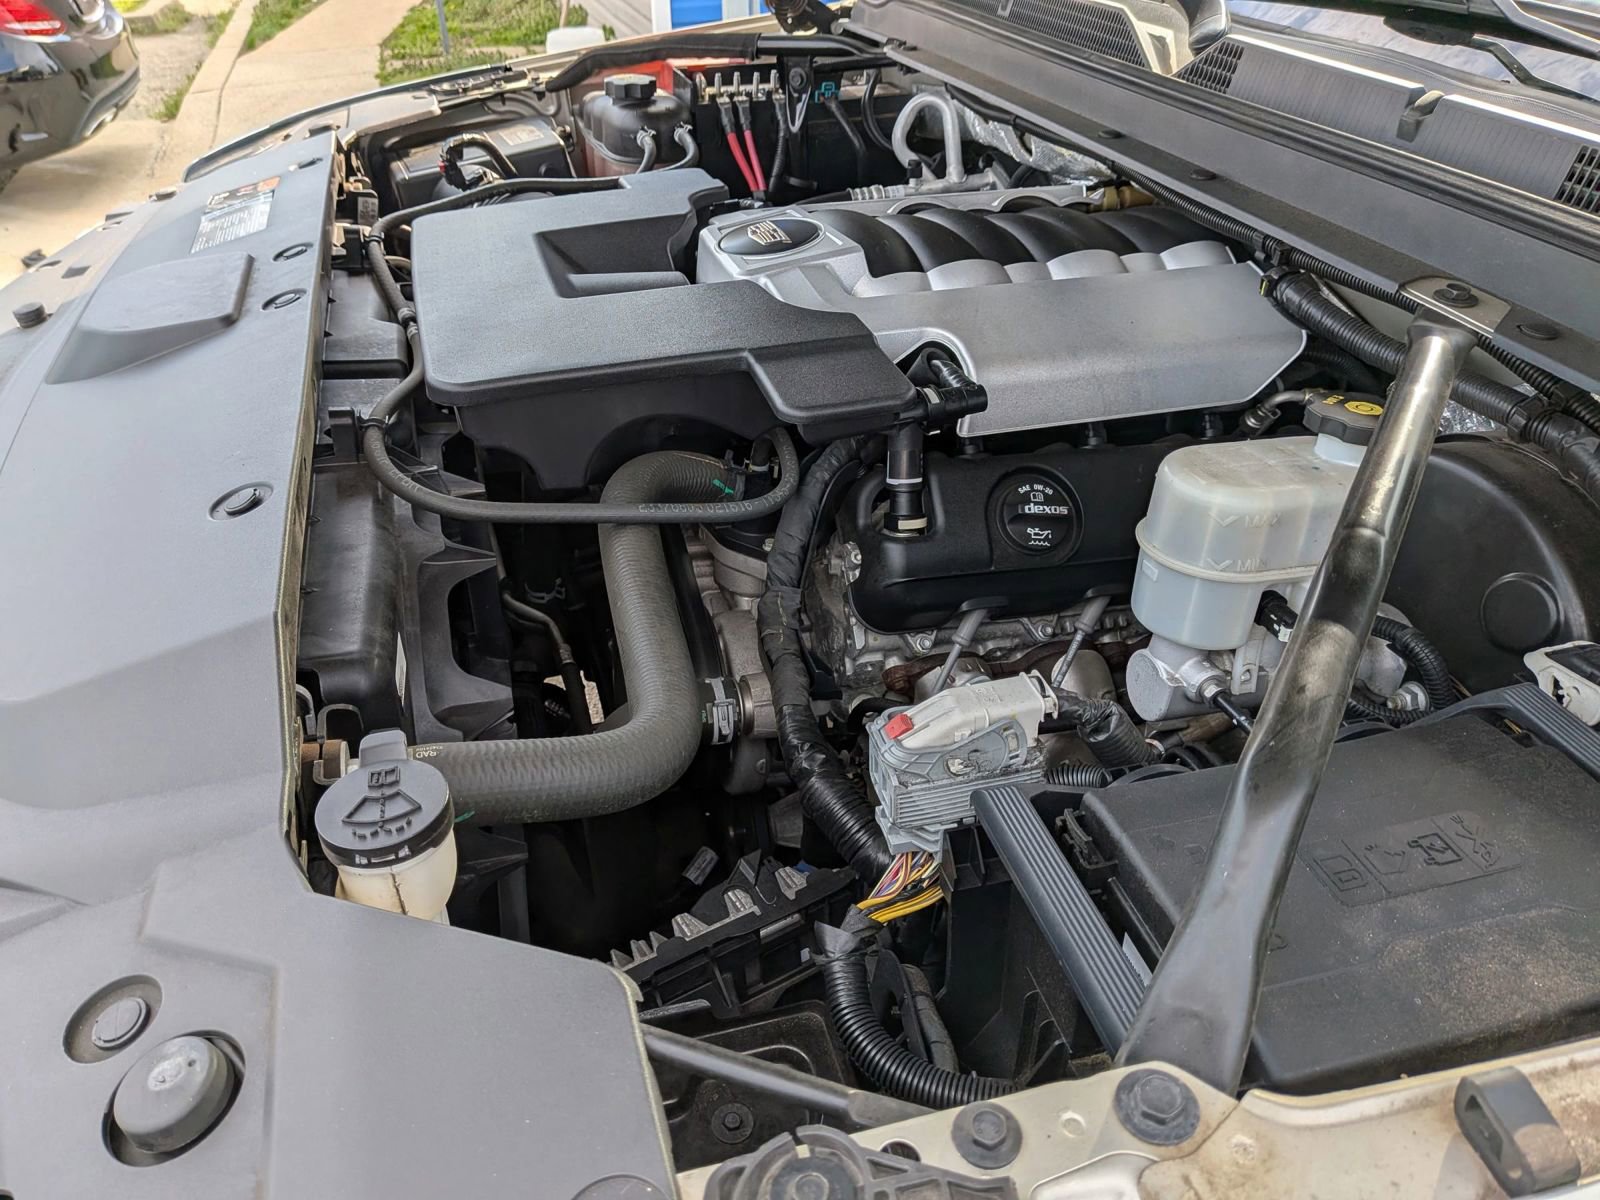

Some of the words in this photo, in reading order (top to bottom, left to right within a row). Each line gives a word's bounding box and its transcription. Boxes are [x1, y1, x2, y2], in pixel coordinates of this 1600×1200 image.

[1018, 485, 1031, 494] SAE
[1033, 484, 1053, 495] 0W-20
[1024, 503, 1069, 515] dexos
[416, 750, 437, 758] RAD
